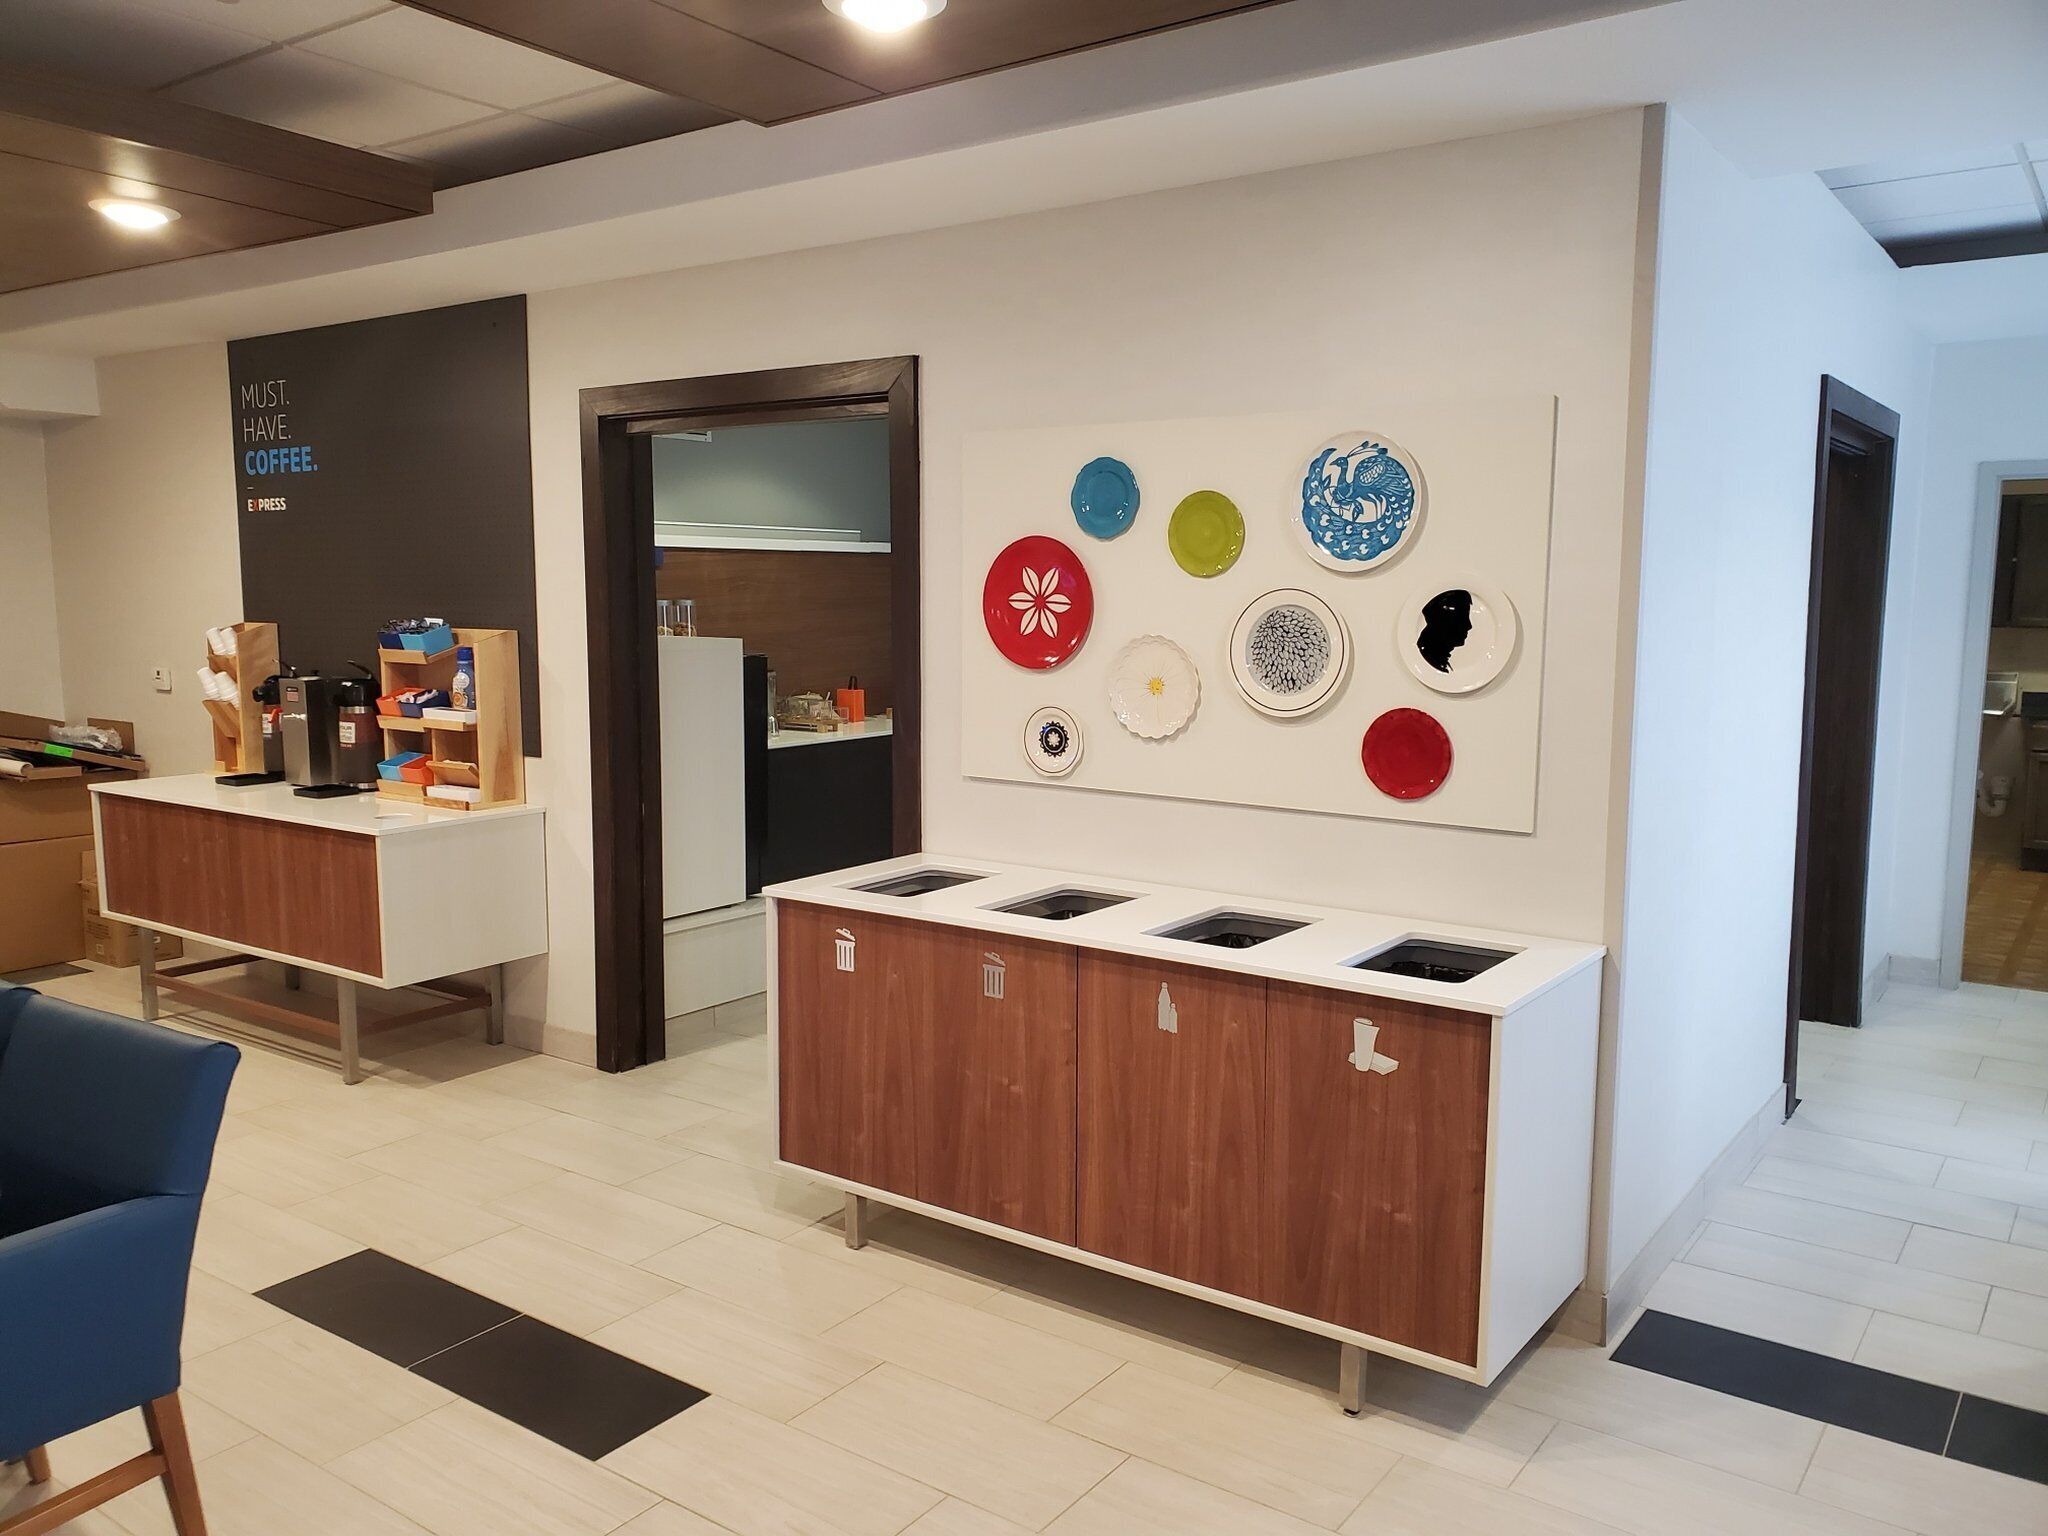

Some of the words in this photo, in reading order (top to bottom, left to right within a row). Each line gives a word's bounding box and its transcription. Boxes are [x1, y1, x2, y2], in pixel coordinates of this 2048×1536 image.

[241, 379, 290, 410] MUST.
[243, 414, 292, 443] HAVE.
[245, 446, 318, 476] COFFEE.
[247, 497, 287, 512] EXPRESS
